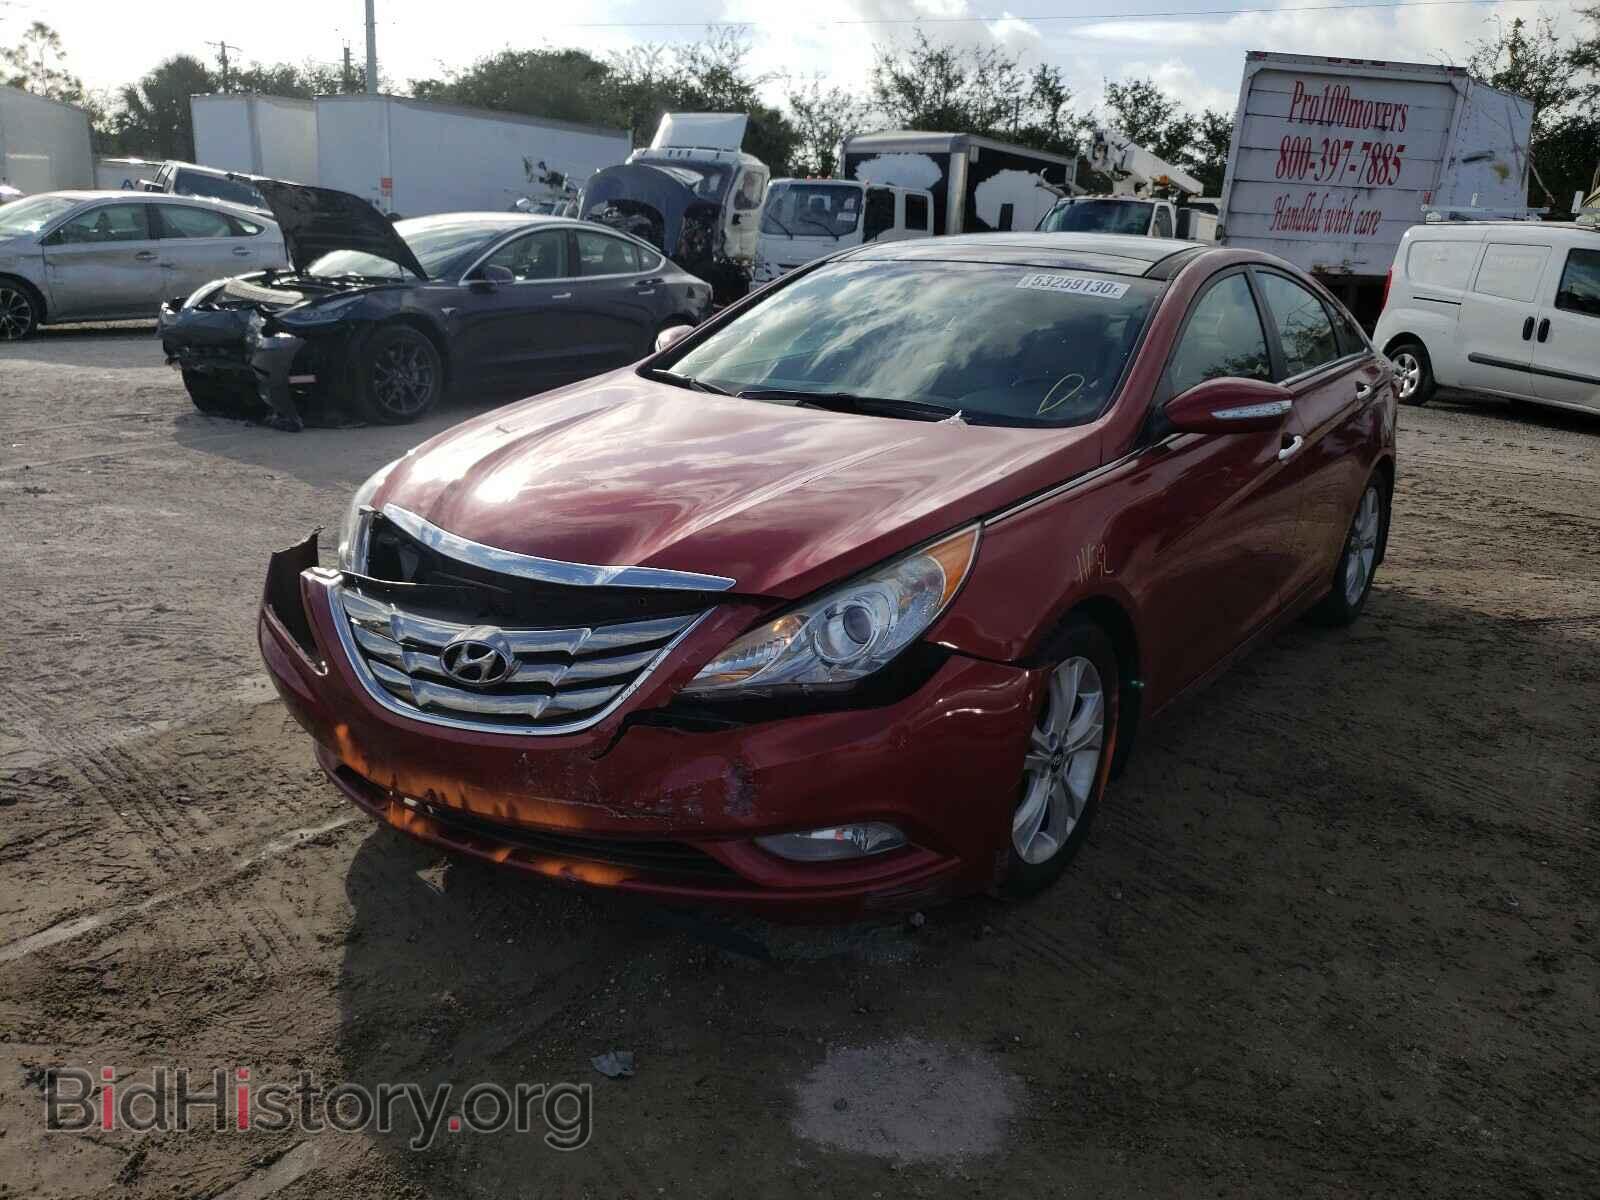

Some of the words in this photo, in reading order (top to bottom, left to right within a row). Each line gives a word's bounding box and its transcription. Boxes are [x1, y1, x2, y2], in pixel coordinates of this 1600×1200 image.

[1288, 80, 1408, 132] Pro100movers
[1275, 135, 1406, 186] 800-397-7885
[1270, 192, 1329, 232] Handled
[1323, 192, 1357, 235] with
[1353, 209, 1382, 235] care
